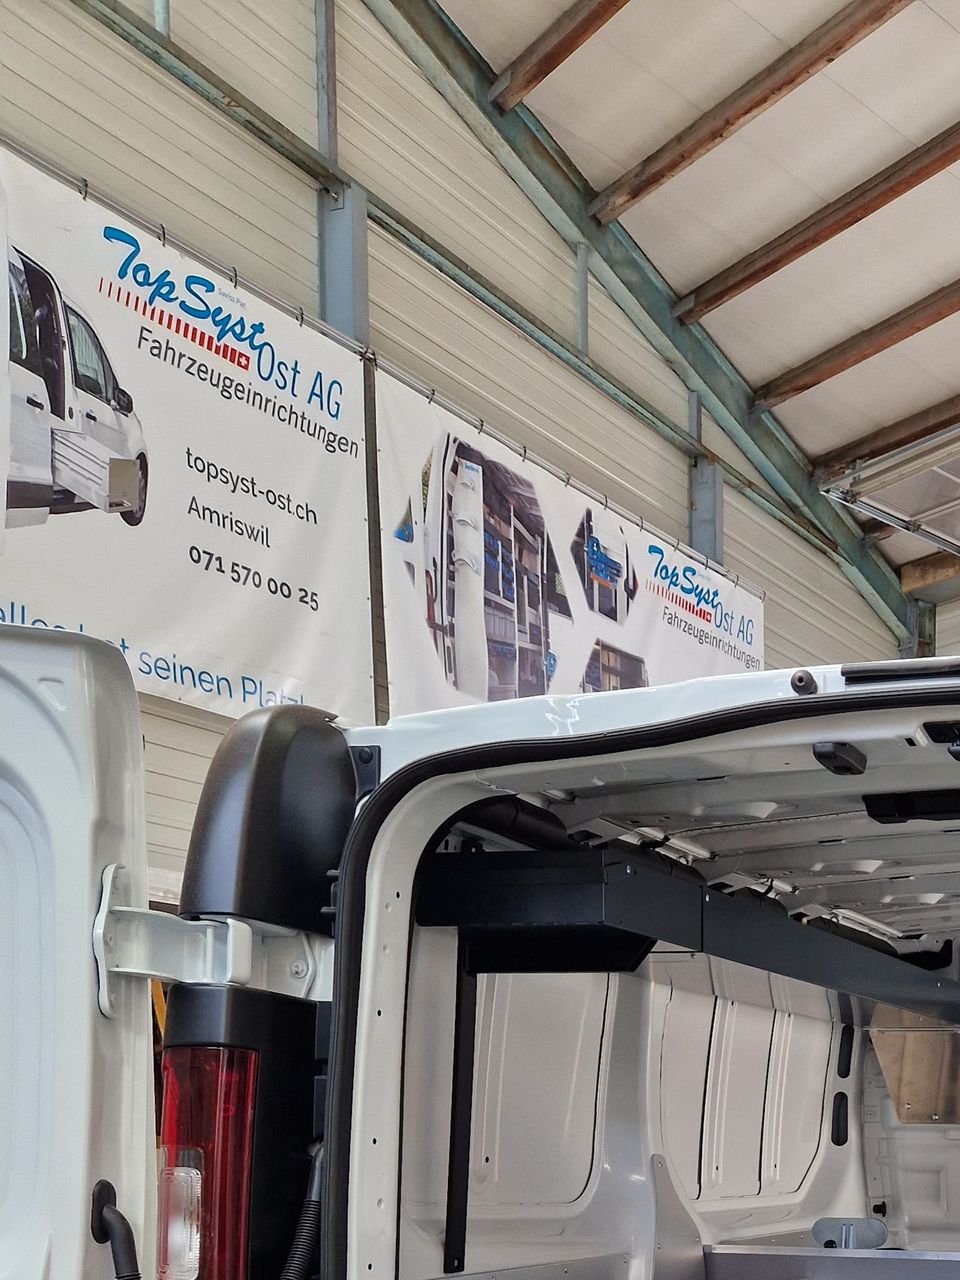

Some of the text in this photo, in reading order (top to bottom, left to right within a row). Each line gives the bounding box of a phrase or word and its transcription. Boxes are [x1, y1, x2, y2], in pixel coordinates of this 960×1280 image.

[137, 326, 359, 459] Fahrzeugeinrichtungen
[256, 341, 301, 398] Ost
[307, 371, 343, 420] AG
[186, 447, 317, 525] topsyst-ost.ch
[187, 496, 271, 548] Amriswil
[189, 546, 319, 611] 071 570 00 25
[662, 605, 761, 671] Fahrzeugeinrichtungen
[714, 601, 735, 635] Ost
[737, 615, 754, 645] AG
[138, 651, 233, 698] seinen
